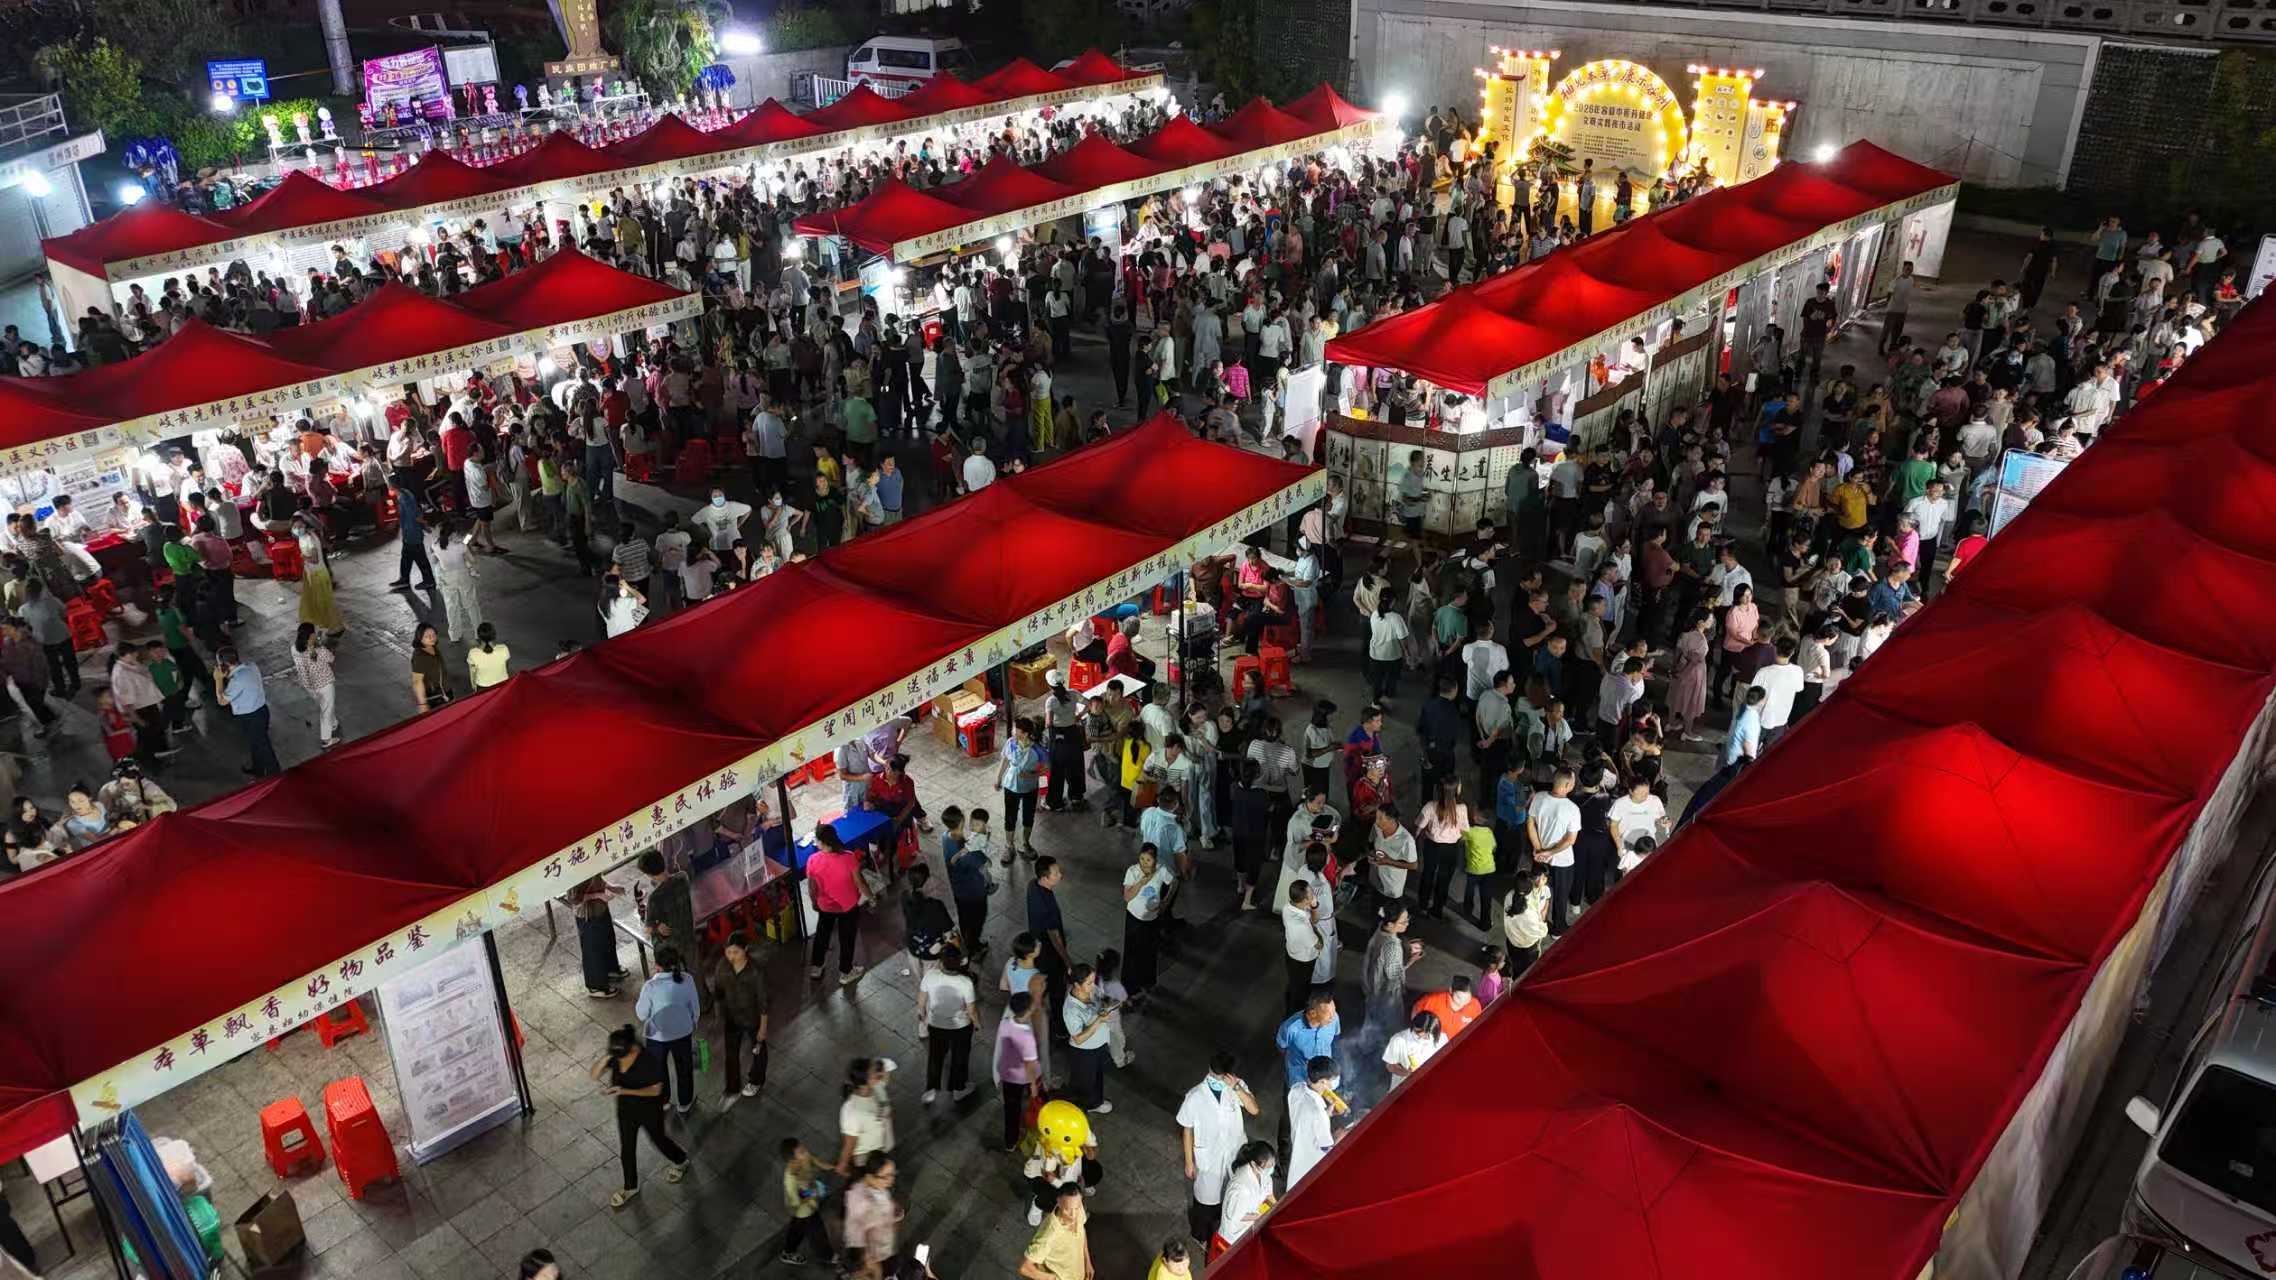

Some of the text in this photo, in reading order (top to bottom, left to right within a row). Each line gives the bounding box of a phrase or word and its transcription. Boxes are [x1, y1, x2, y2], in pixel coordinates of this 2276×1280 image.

[0, 436, 79, 467] 医义诊区
[1423, 453, 1488, 483] 养生之道
[1026, 553, 1169, 634] 传承中医药 奋进新征程
[823, 648, 976, 738] 望闻问切 送福安康
[544, 769, 739, 879] 巧施外治 惠民体验
[153, 924, 431, 1072] 本草飘香 好物品鉴
